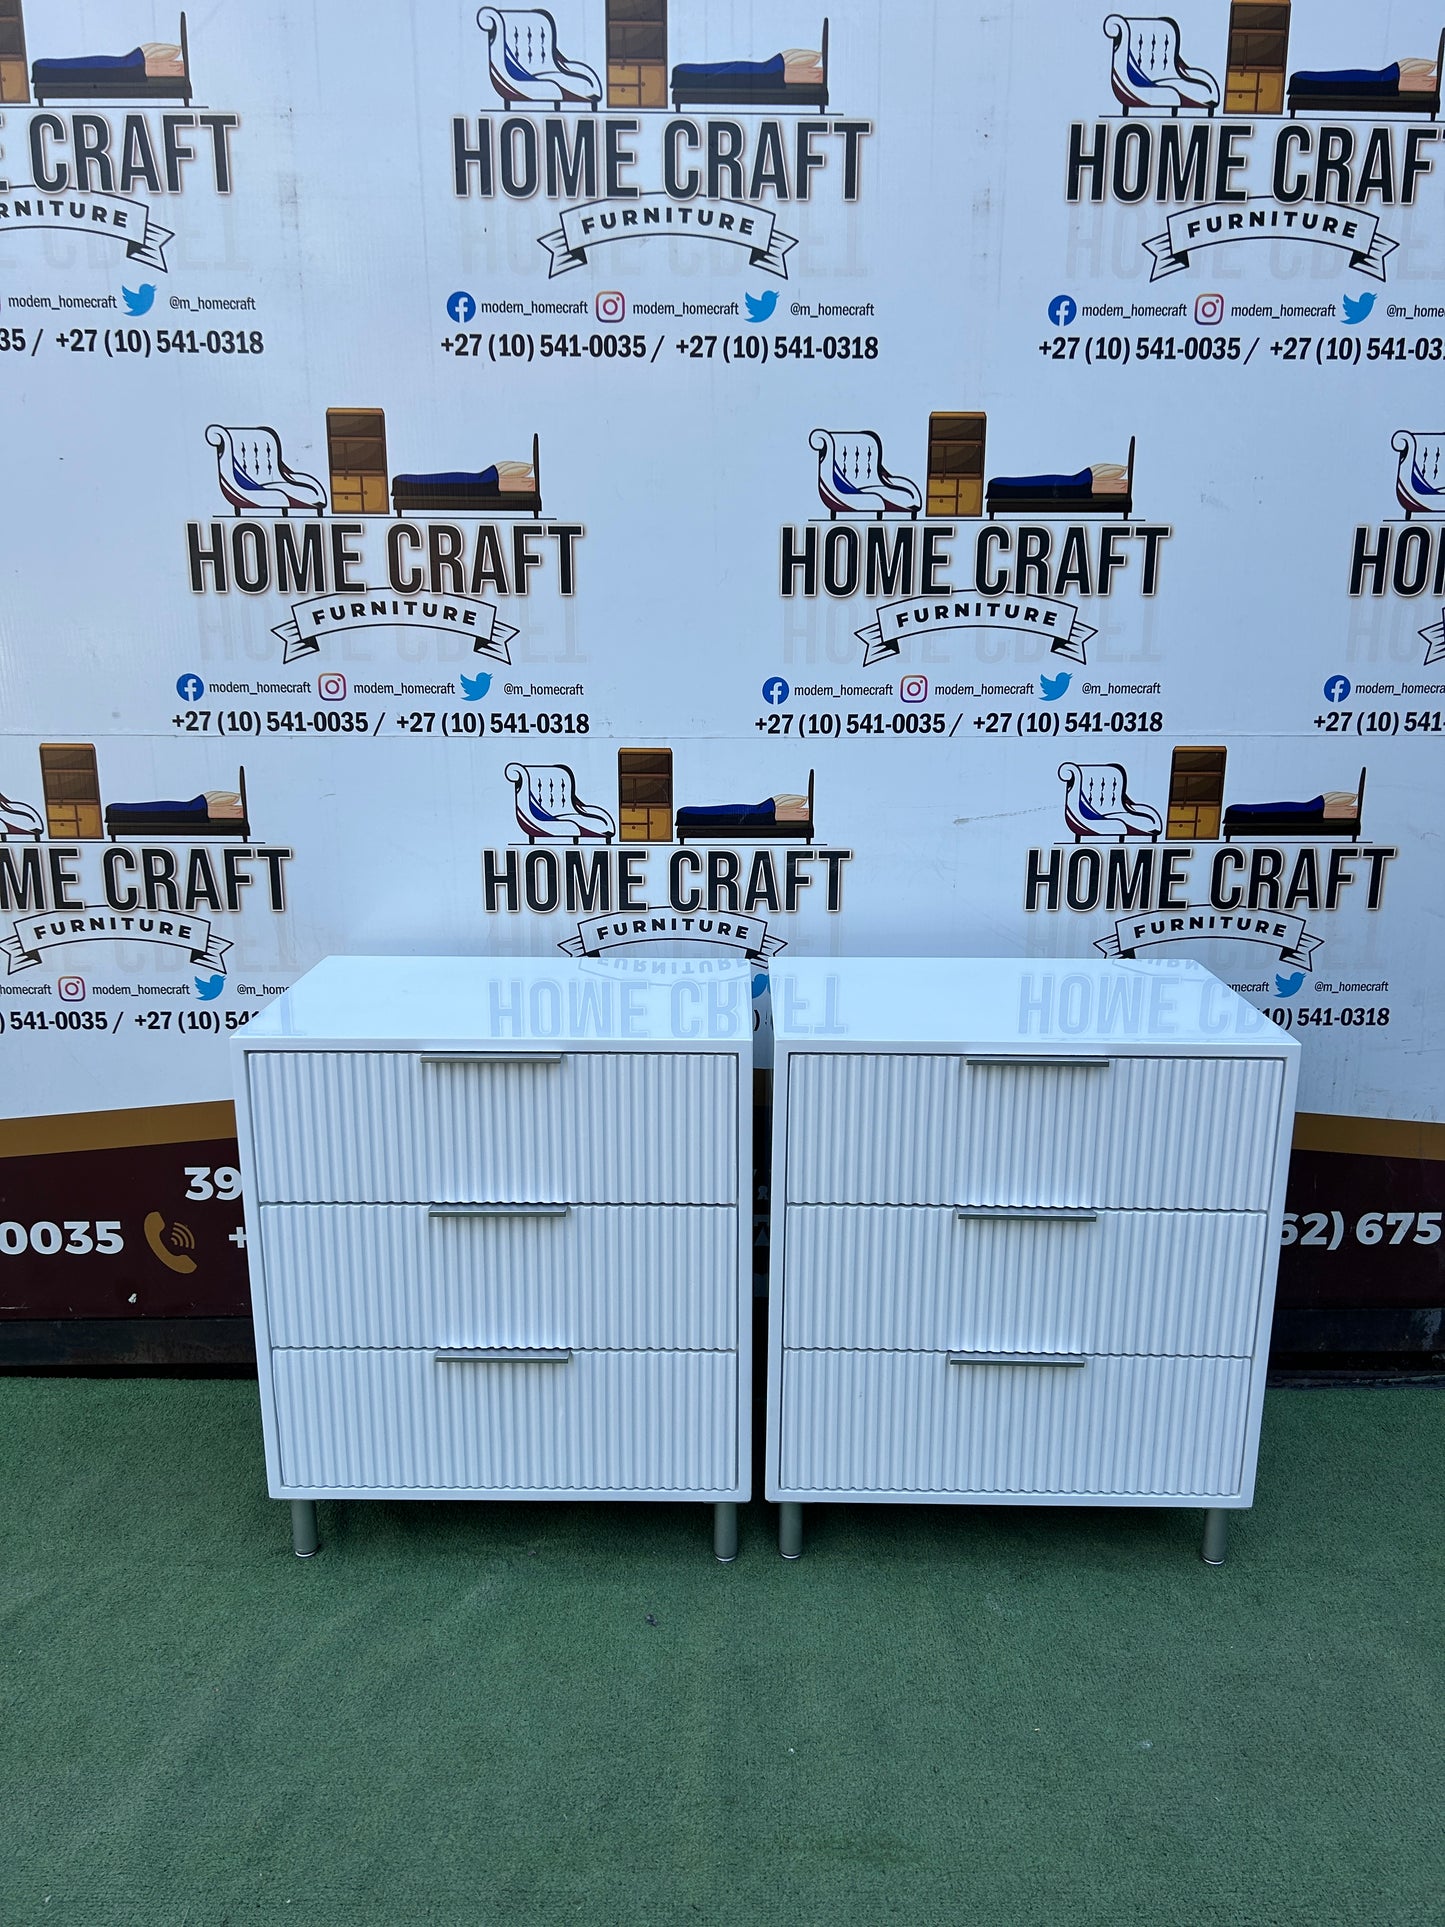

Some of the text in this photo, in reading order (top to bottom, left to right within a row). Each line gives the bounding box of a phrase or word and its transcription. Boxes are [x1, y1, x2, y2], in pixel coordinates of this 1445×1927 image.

[29, 113, 238, 193] CRAFT
[452, 117, 870, 201] HOME CRAFT
[1066, 122, 1445, 204] HOME CRAF
[581, 207, 755, 236] FURNITURE
[1187, 211, 1358, 239] FURNITURE
[169, 296, 256, 312] @m_homecraft
[790, 303, 875, 319] @m_homecraft
[1386, 304, 1445, 320] @m_home
[56, 329, 98, 352] +27
[104, 329, 151, 358] (10)
[157, 330, 265, 354] 541-0318
[441, 334, 482, 357] +27
[488, 334, 535, 362] (10)
[540, 334, 646, 358] 541-0035
[676, 336, 717, 359] +27
[722, 335, 768, 363] (10)
[774, 336, 879, 359] 541-0318
[1038, 337, 1081, 360] +27
[1085, 337, 1131, 365] (10)
[1136, 337, 1241, 360] 541-0035
[1270, 338, 1311, 360] +27
[1316, 338, 1362, 365] (10)
[1367, 338, 1445, 361] 541-03
[185, 521, 584, 596] HOME CRAFT
[780, 525, 1171, 597] HOME CRAFT
[1347, 525, 1445, 597] HO
[312, 601, 477, 626] FURNITURE
[896, 602, 1058, 628] FURNITURE
[503, 683, 584, 697] @m_homecraft
[1082, 682, 1161, 697] @m_homecraft
[172, 711, 212, 732] +27
[217, 711, 262, 736] (10)
[267, 711, 368, 733] 541-0035
[396, 713, 435, 733] +27
[441, 713, 485, 737] (10)
[490, 713, 590, 734] 541-0318
[755, 714, 794, 734] +27
[799, 714, 841, 738] (10)
[846, 714, 946, 734] 541-0035
[973, 713, 1012, 733] +27
[1017, 712, 1060, 737] (10)
[1064, 712, 1163, 733] 541-0318
[1313, 712, 1353, 732] +27
[1357, 712, 1399, 736] (10)
[102, 847, 291, 912] CRAFT
[482, 849, 852, 913] HOME CRAFT
[1024, 847, 1396, 912] HOME CRAFT
[33, 917, 192, 939] FURNITURE
[596, 918, 749, 940] FURNITURE
[1133, 916, 1287, 938] FURNITURE
[1314, 981, 1389, 994] @m_homecraft
[10, 1010, 108, 1030] 541-0035
[135, 1011, 172, 1030] +27
[178, 1011, 221, 1034] (10)
[1297, 1007, 1390, 1026] 541-0318
[1355, 1212, 1443, 1245] 675
